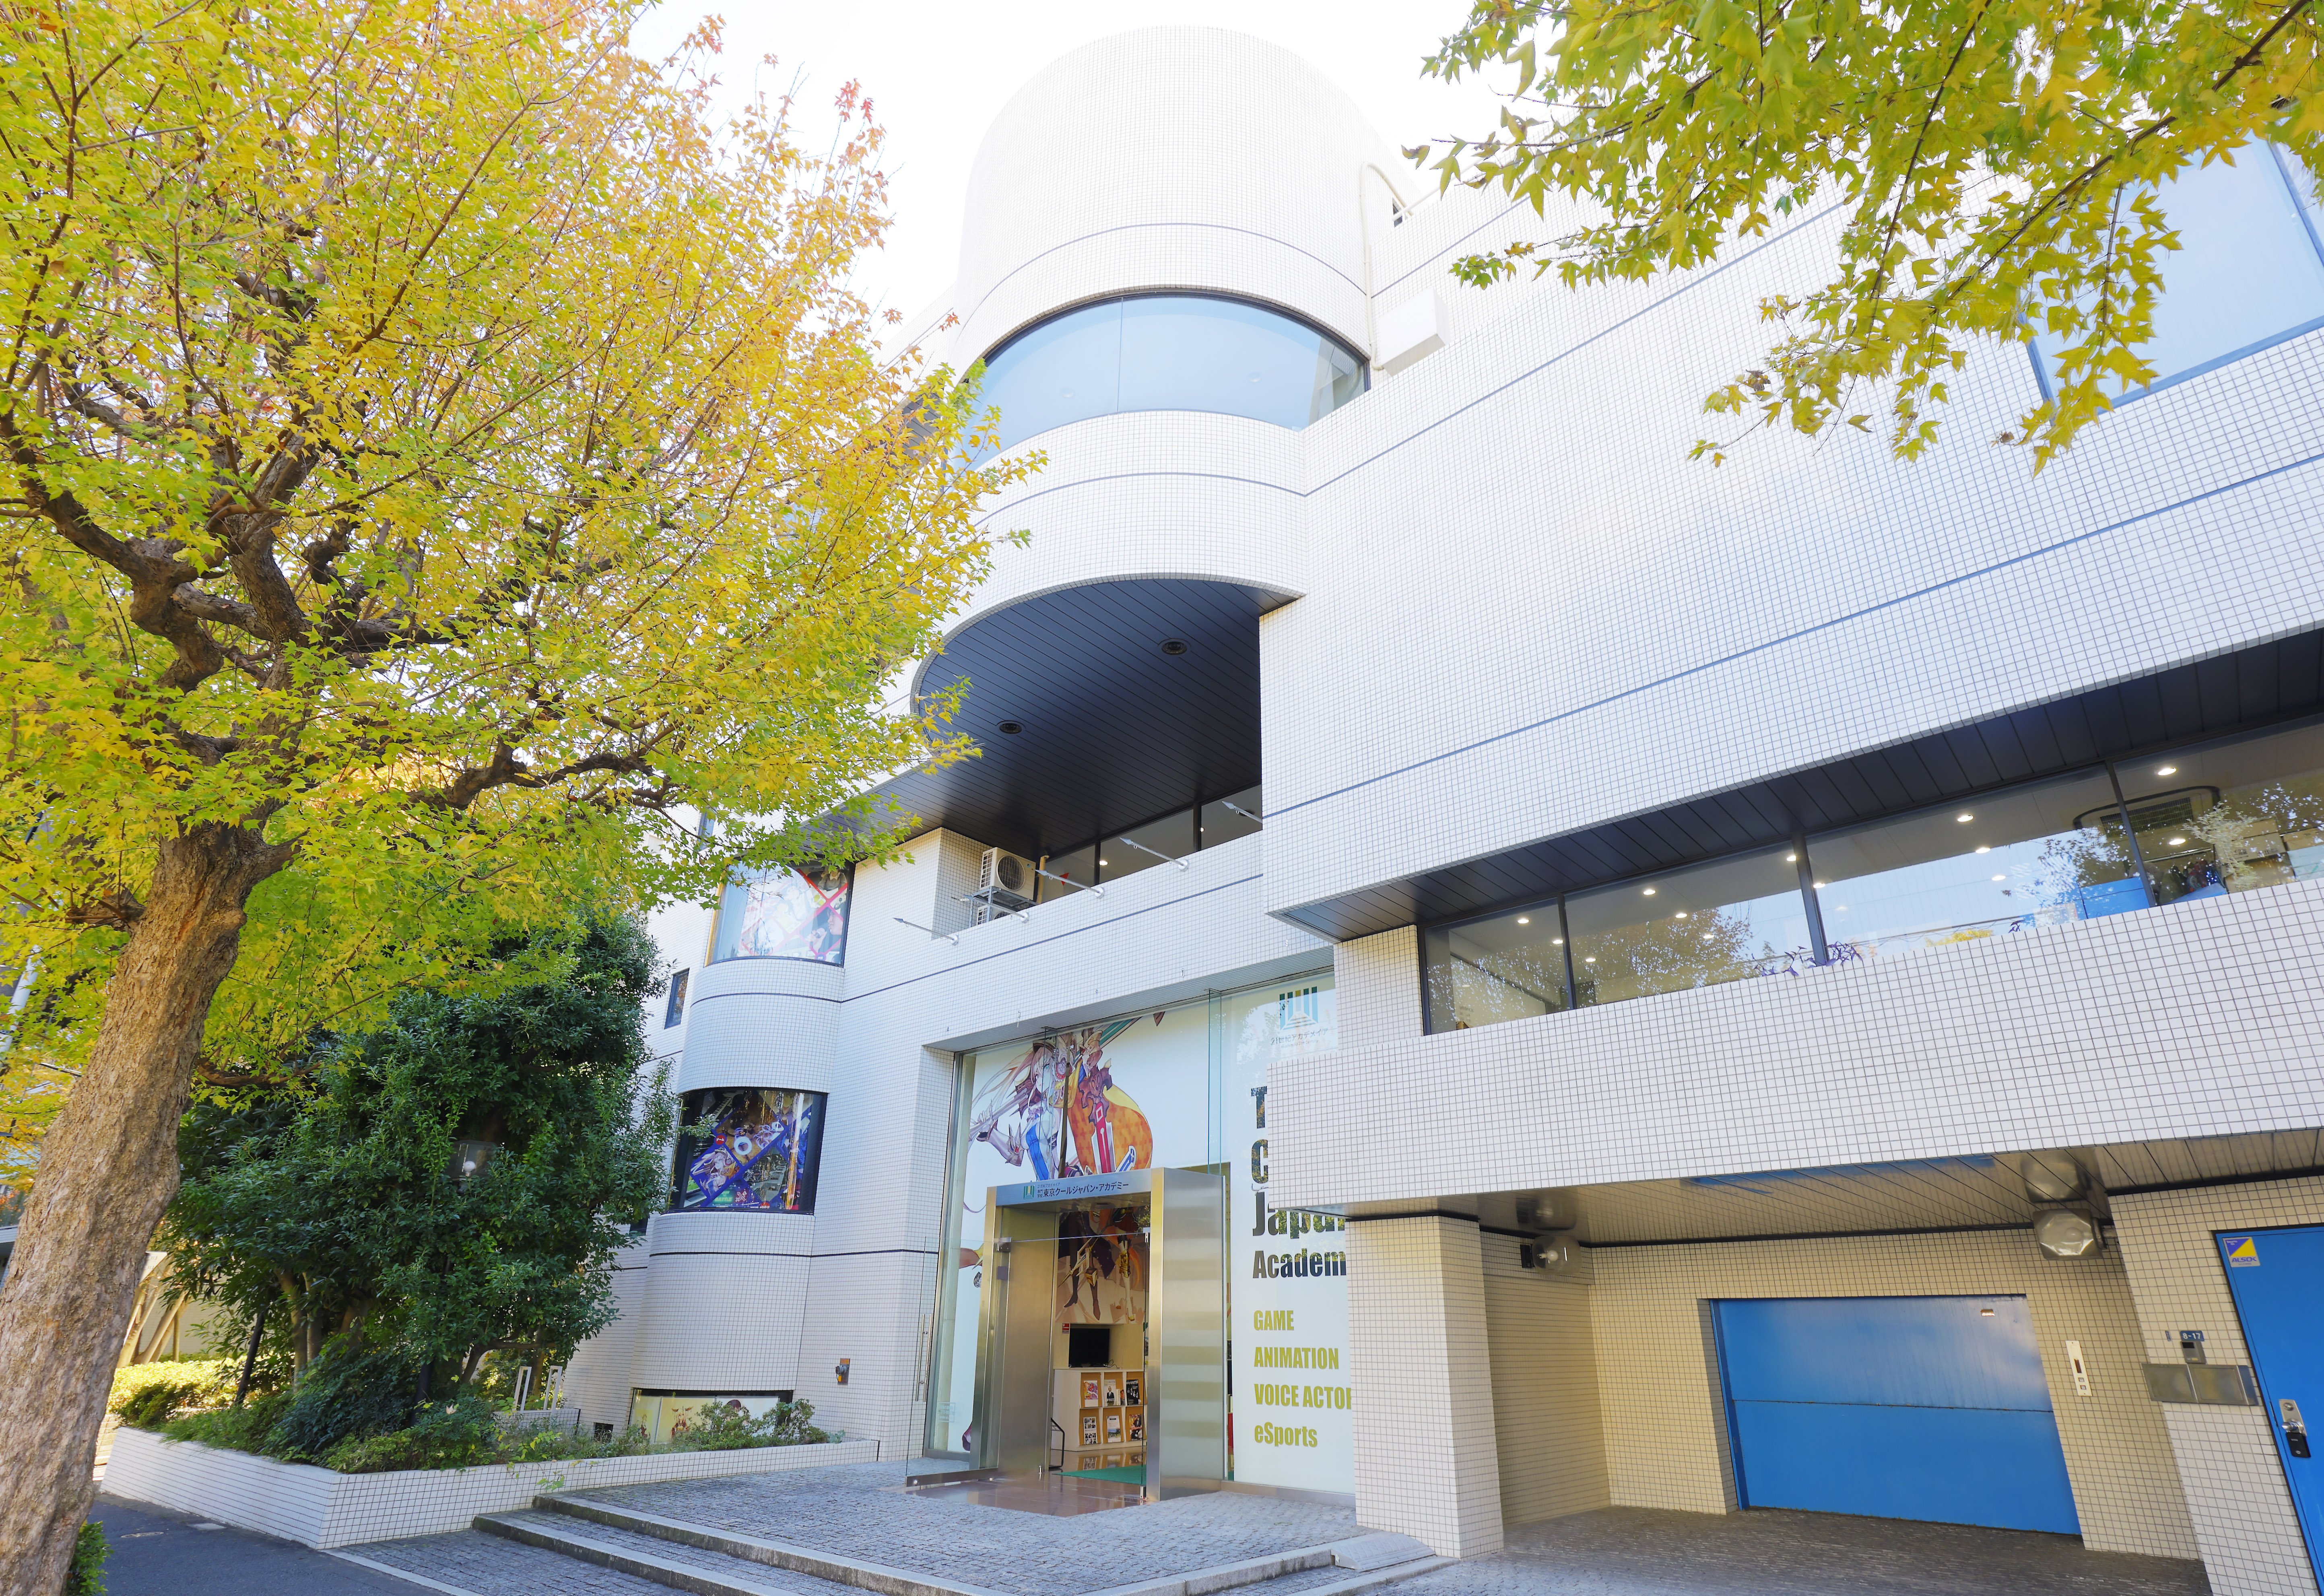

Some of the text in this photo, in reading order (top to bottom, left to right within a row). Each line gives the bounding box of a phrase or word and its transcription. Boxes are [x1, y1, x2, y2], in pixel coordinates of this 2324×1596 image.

[1271, 1028, 1328, 1045] 21世紀アカデメイア
[1043, 1182, 1129, 1197] 東京クールジャパン・アカデミー
[1253, 1192, 1345, 1239] Japa
[1253, 1248, 1347, 1278] Academ
[1254, 1310, 1294, 1330] GAME
[1254, 1347, 1339, 1369] ANIMATION
[1254, 1384, 1299, 1406] VOICE
[1254, 1422, 1318, 1448] eSports
